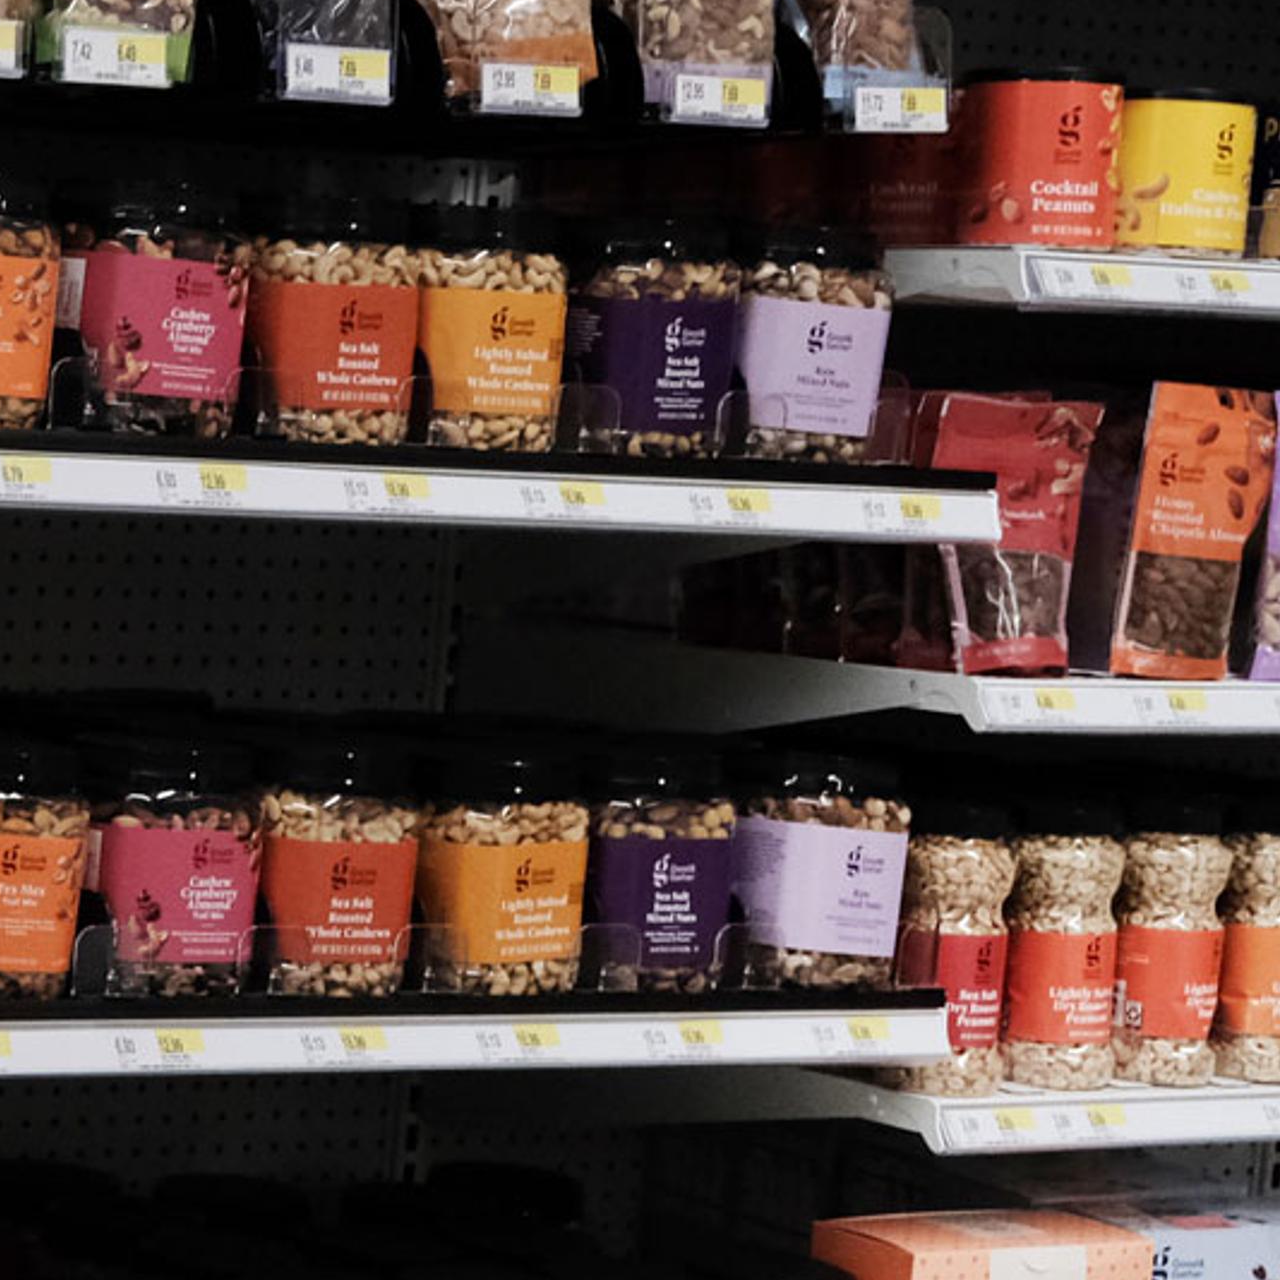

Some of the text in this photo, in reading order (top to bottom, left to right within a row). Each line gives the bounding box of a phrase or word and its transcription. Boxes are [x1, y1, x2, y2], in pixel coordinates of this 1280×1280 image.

[1030, 178, 1099, 199] Cocktail
[1032, 197, 1095, 216] Peanuts
[171, 306, 210, 322] Cashew
[161, 318, 217, 337] Cranberry
[167, 330, 210, 346] Almond
[338, 354, 380, 370] Roasted
[316, 371, 398, 388] Whole Cashews
